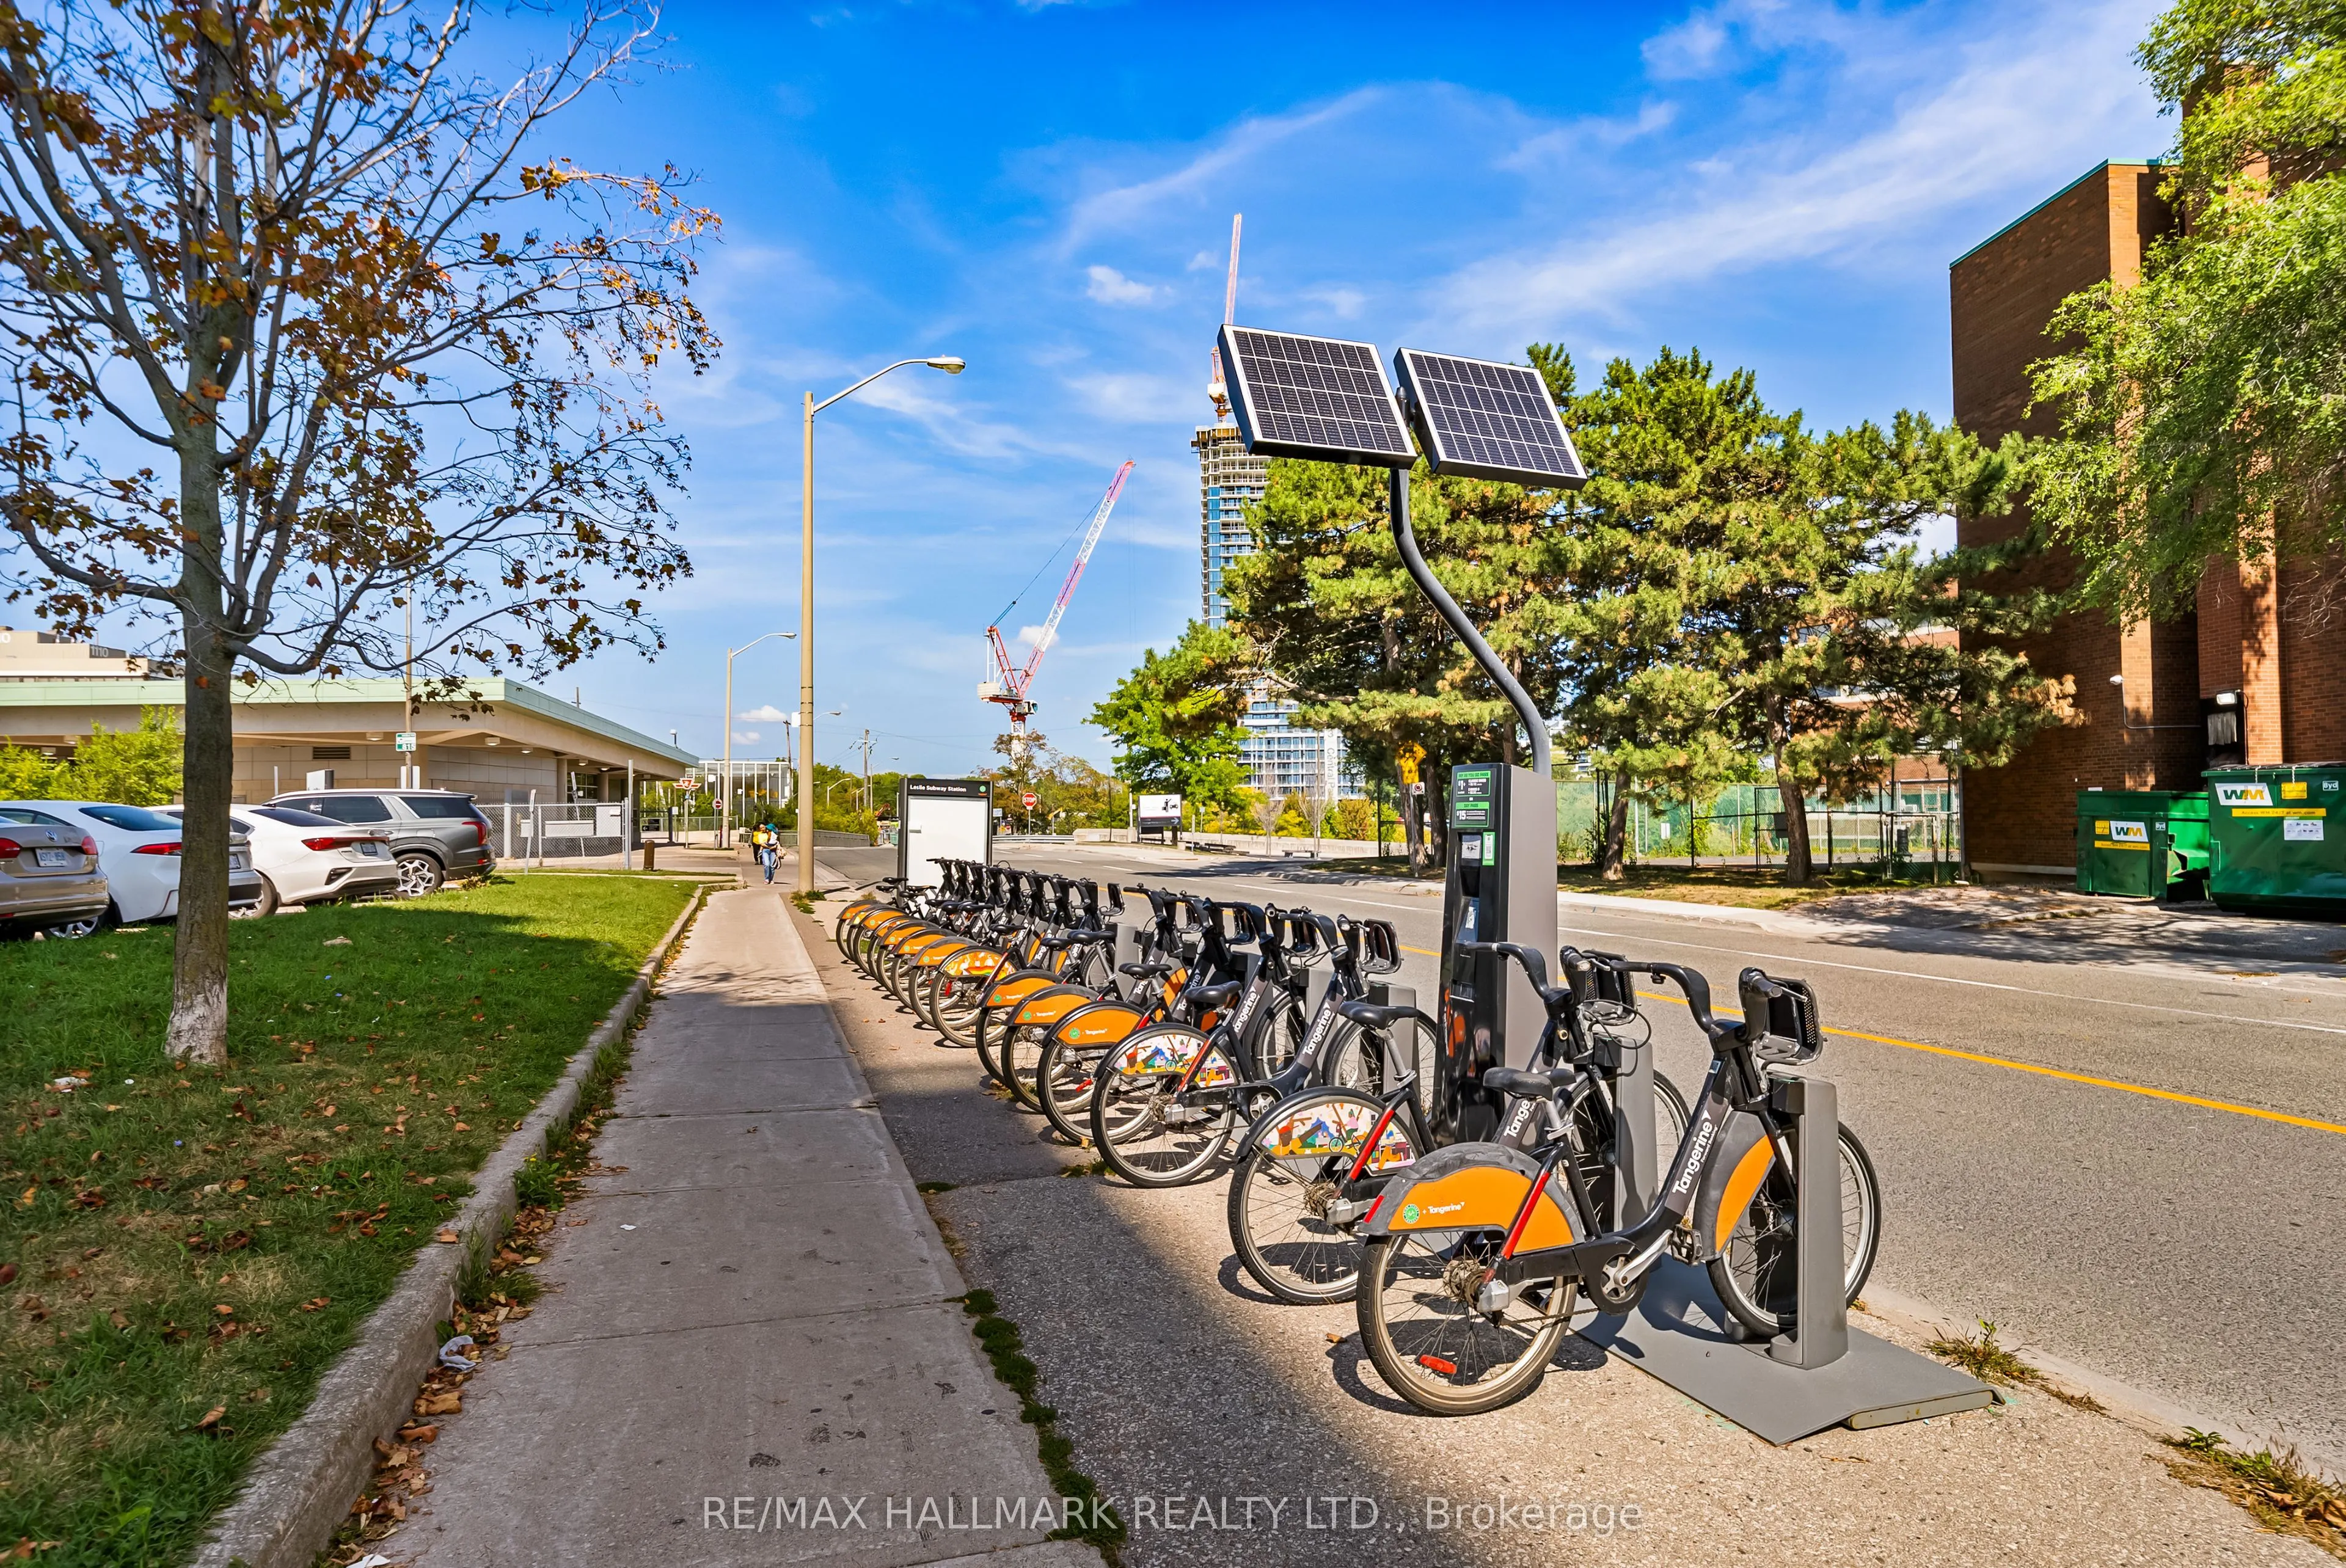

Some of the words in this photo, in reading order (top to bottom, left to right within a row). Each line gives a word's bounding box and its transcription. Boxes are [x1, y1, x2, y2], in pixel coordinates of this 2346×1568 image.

[2223, 789, 2265, 800] WM
[2115, 826, 2143, 837] WM
[1303, 1008, 1331, 1055] Tangerine
[1672, 1121, 1712, 1194] Tangerine
[1700, 1144, 1711, 1163] Forward
[1428, 1203, 1462, 1214] Tangerine
